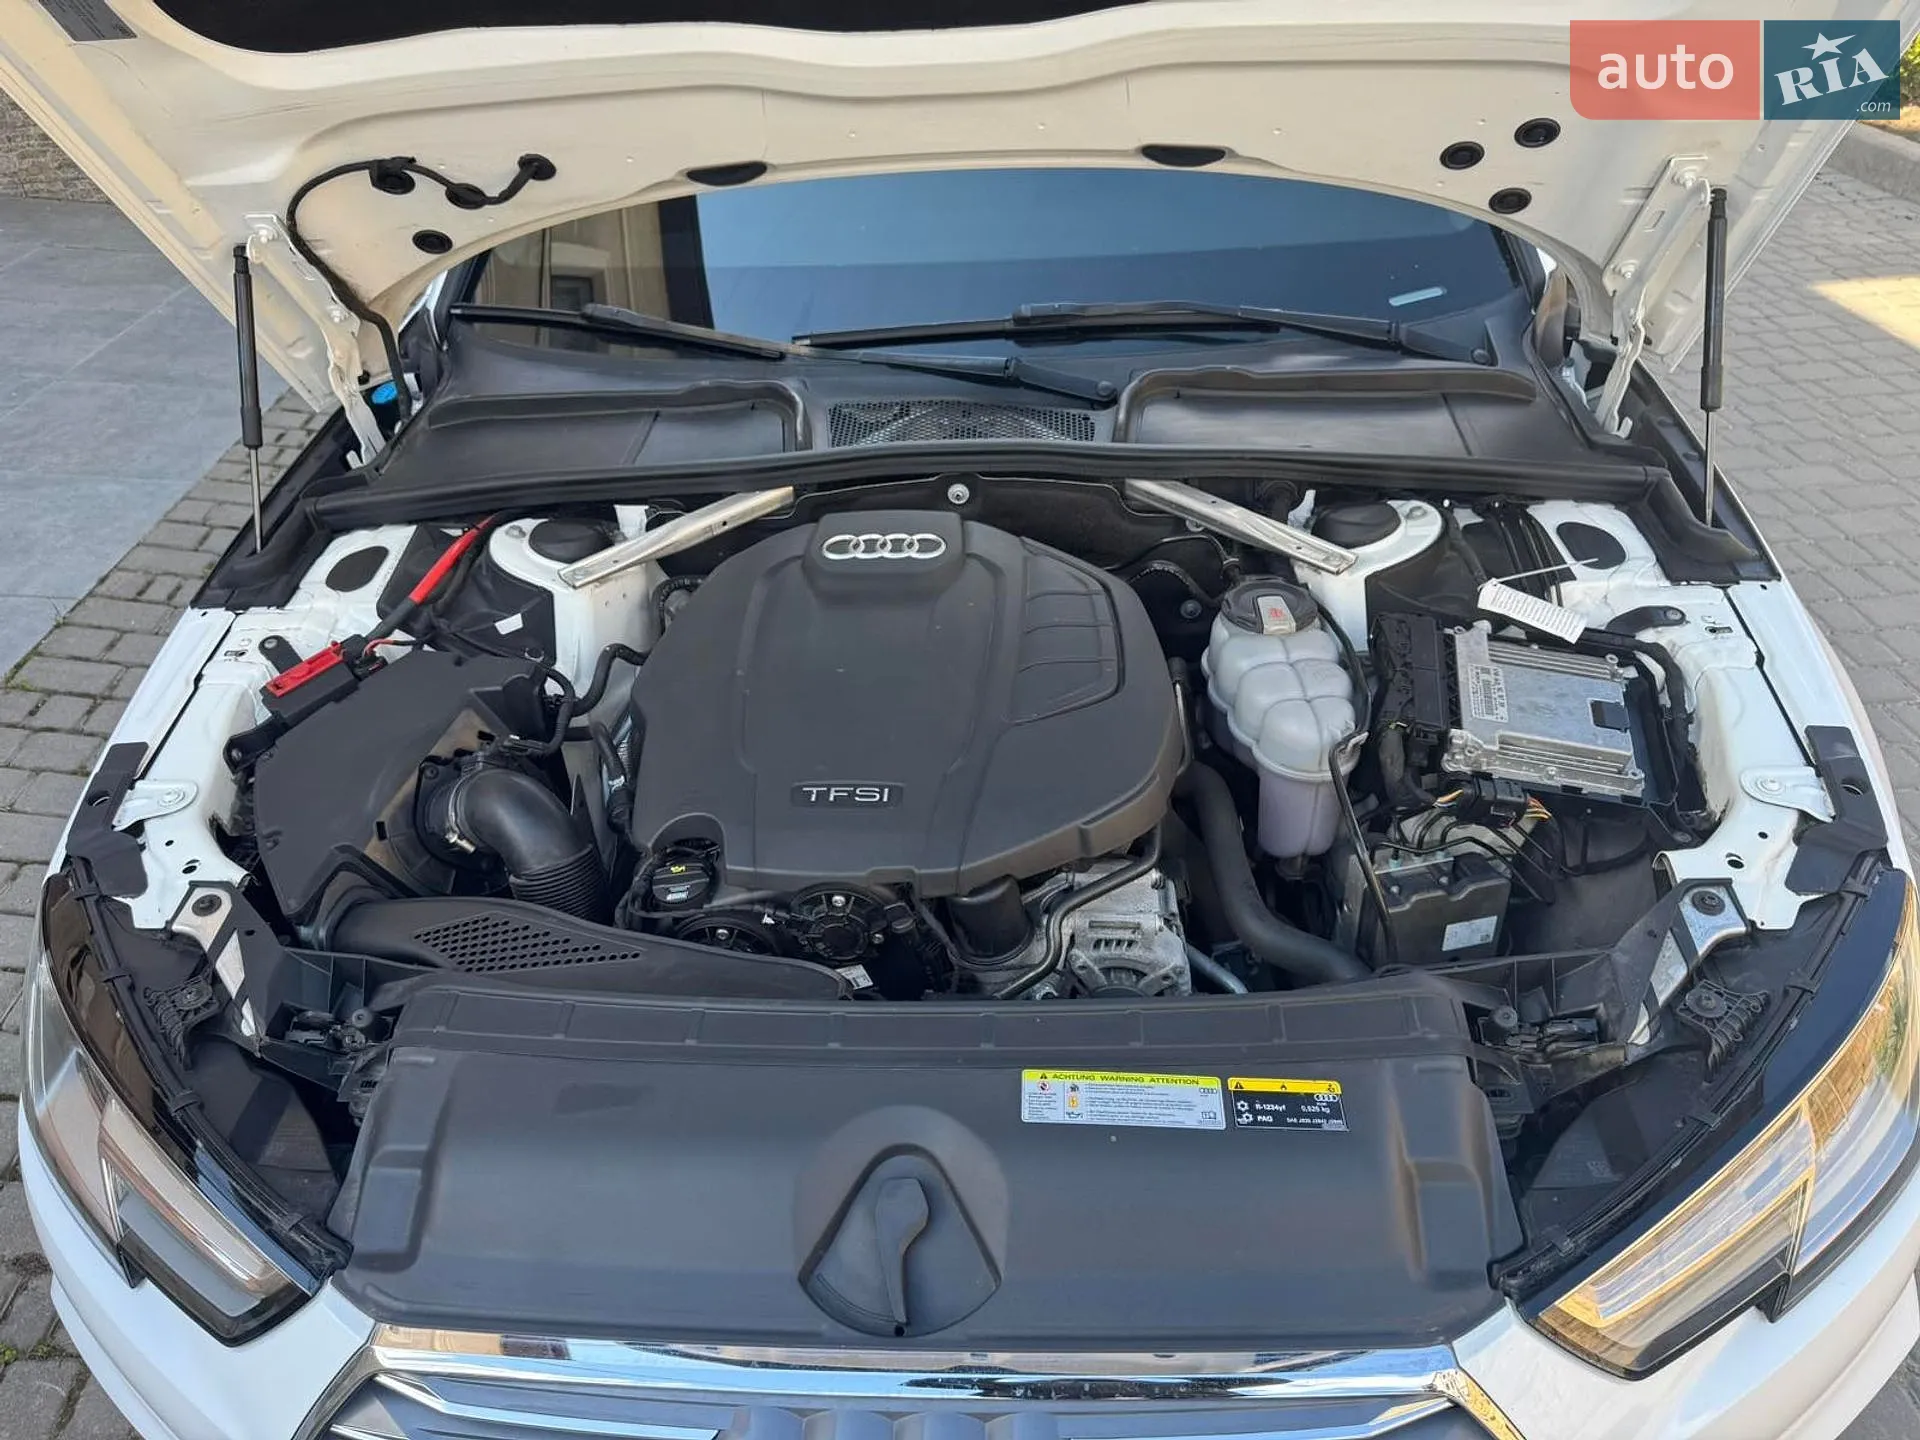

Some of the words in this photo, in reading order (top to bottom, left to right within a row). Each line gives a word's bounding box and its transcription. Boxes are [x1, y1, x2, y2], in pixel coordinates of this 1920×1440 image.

[802, 787, 889, 802] TFSI
[1052, 1073, 1096, 1081] ACHTUNG
[1100, 1075, 1145, 1083] WARNING
[1149, 1077, 1199, 1085] ATTENTION
